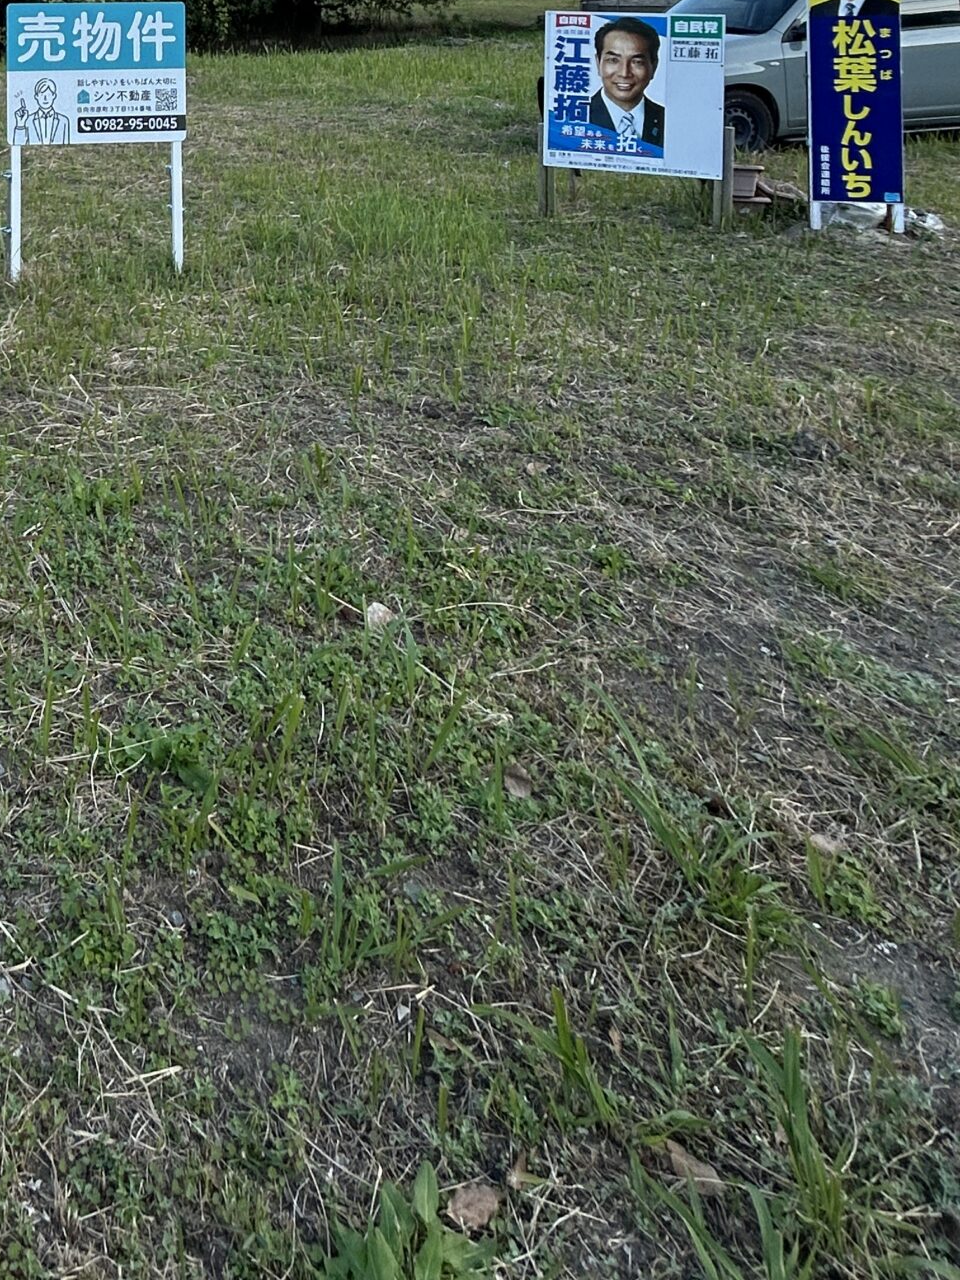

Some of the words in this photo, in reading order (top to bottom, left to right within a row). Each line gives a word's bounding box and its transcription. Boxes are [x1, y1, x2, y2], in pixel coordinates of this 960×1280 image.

[17, 10, 177, 63] 売物件
[558, 15, 588, 26] 自民党
[674, 20, 719, 34] 自民党
[879, 27, 893, 81] まつば
[93, 89, 152, 102] シン不動産
[554, 36, 590, 123] 江藤拓
[94, 117, 178, 131] 0982-95-0045
[832, 19, 878, 199] 松葉しんいち
